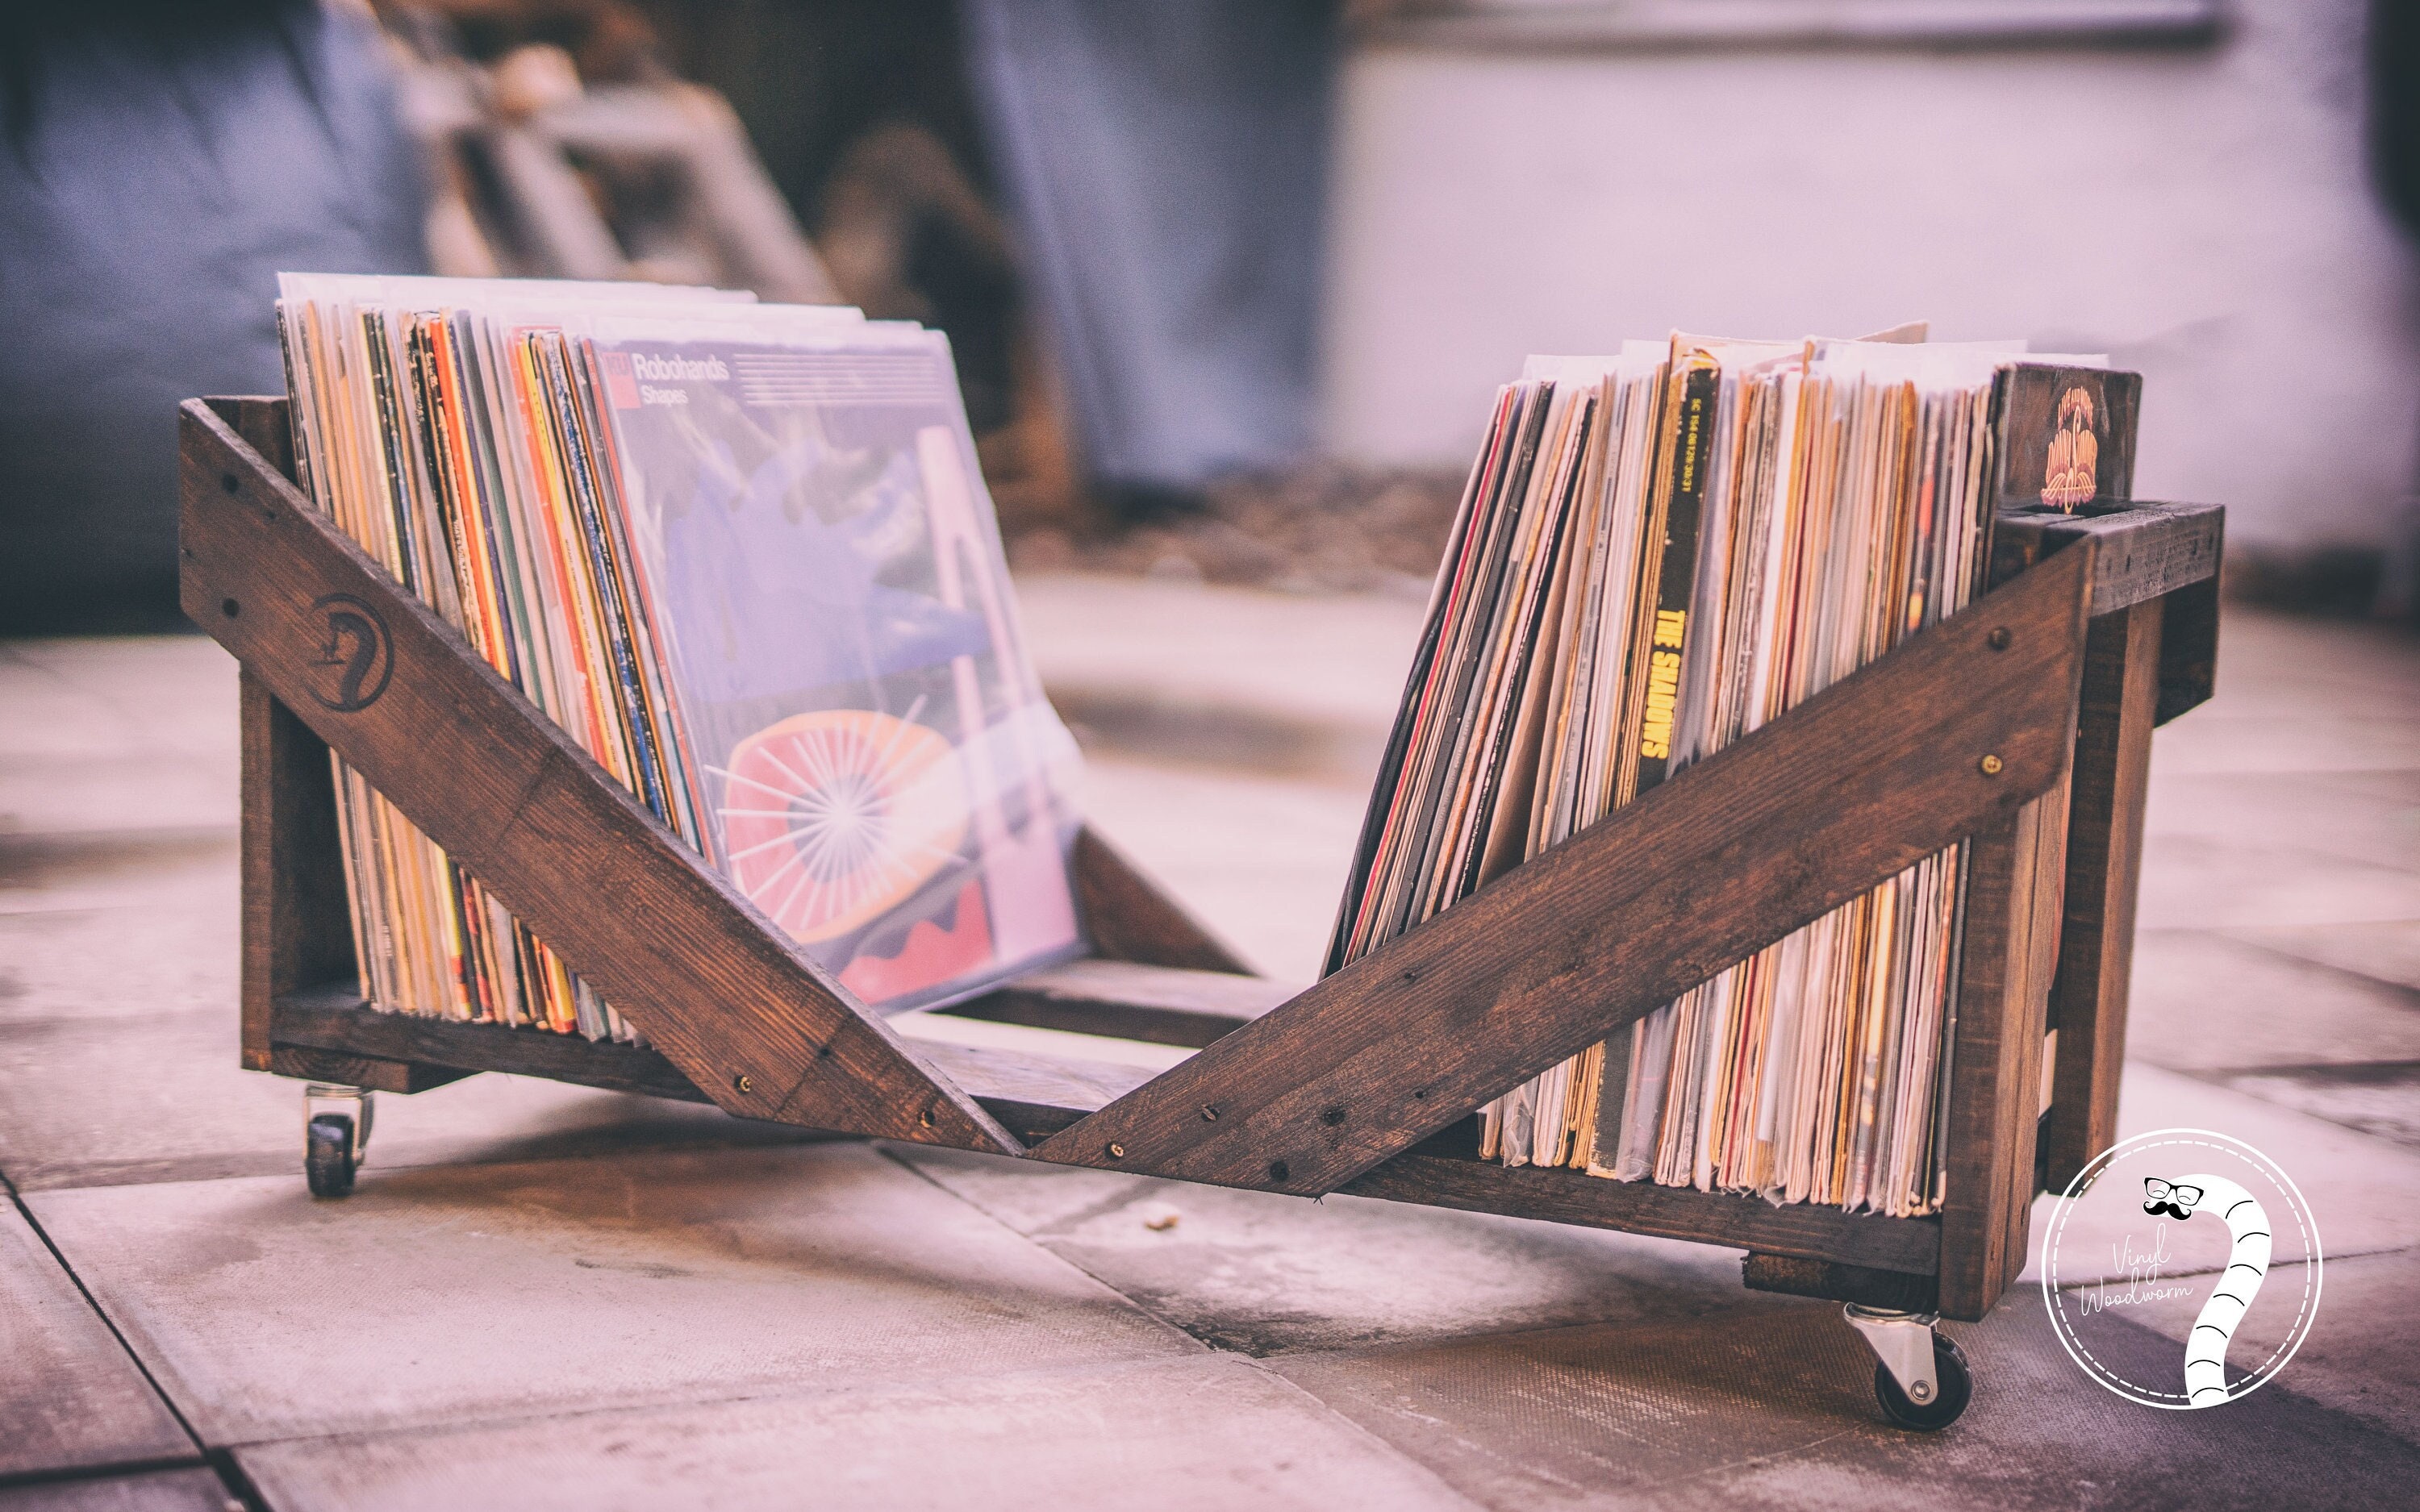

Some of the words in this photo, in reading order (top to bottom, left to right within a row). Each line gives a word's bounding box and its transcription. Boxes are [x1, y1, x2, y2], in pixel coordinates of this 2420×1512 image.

[632, 352, 729, 381] Robohands
[641, 384, 689, 407] Shapes
[1654, 610, 1687, 649] THE
[1641, 651, 1681, 760] SHADOWS
